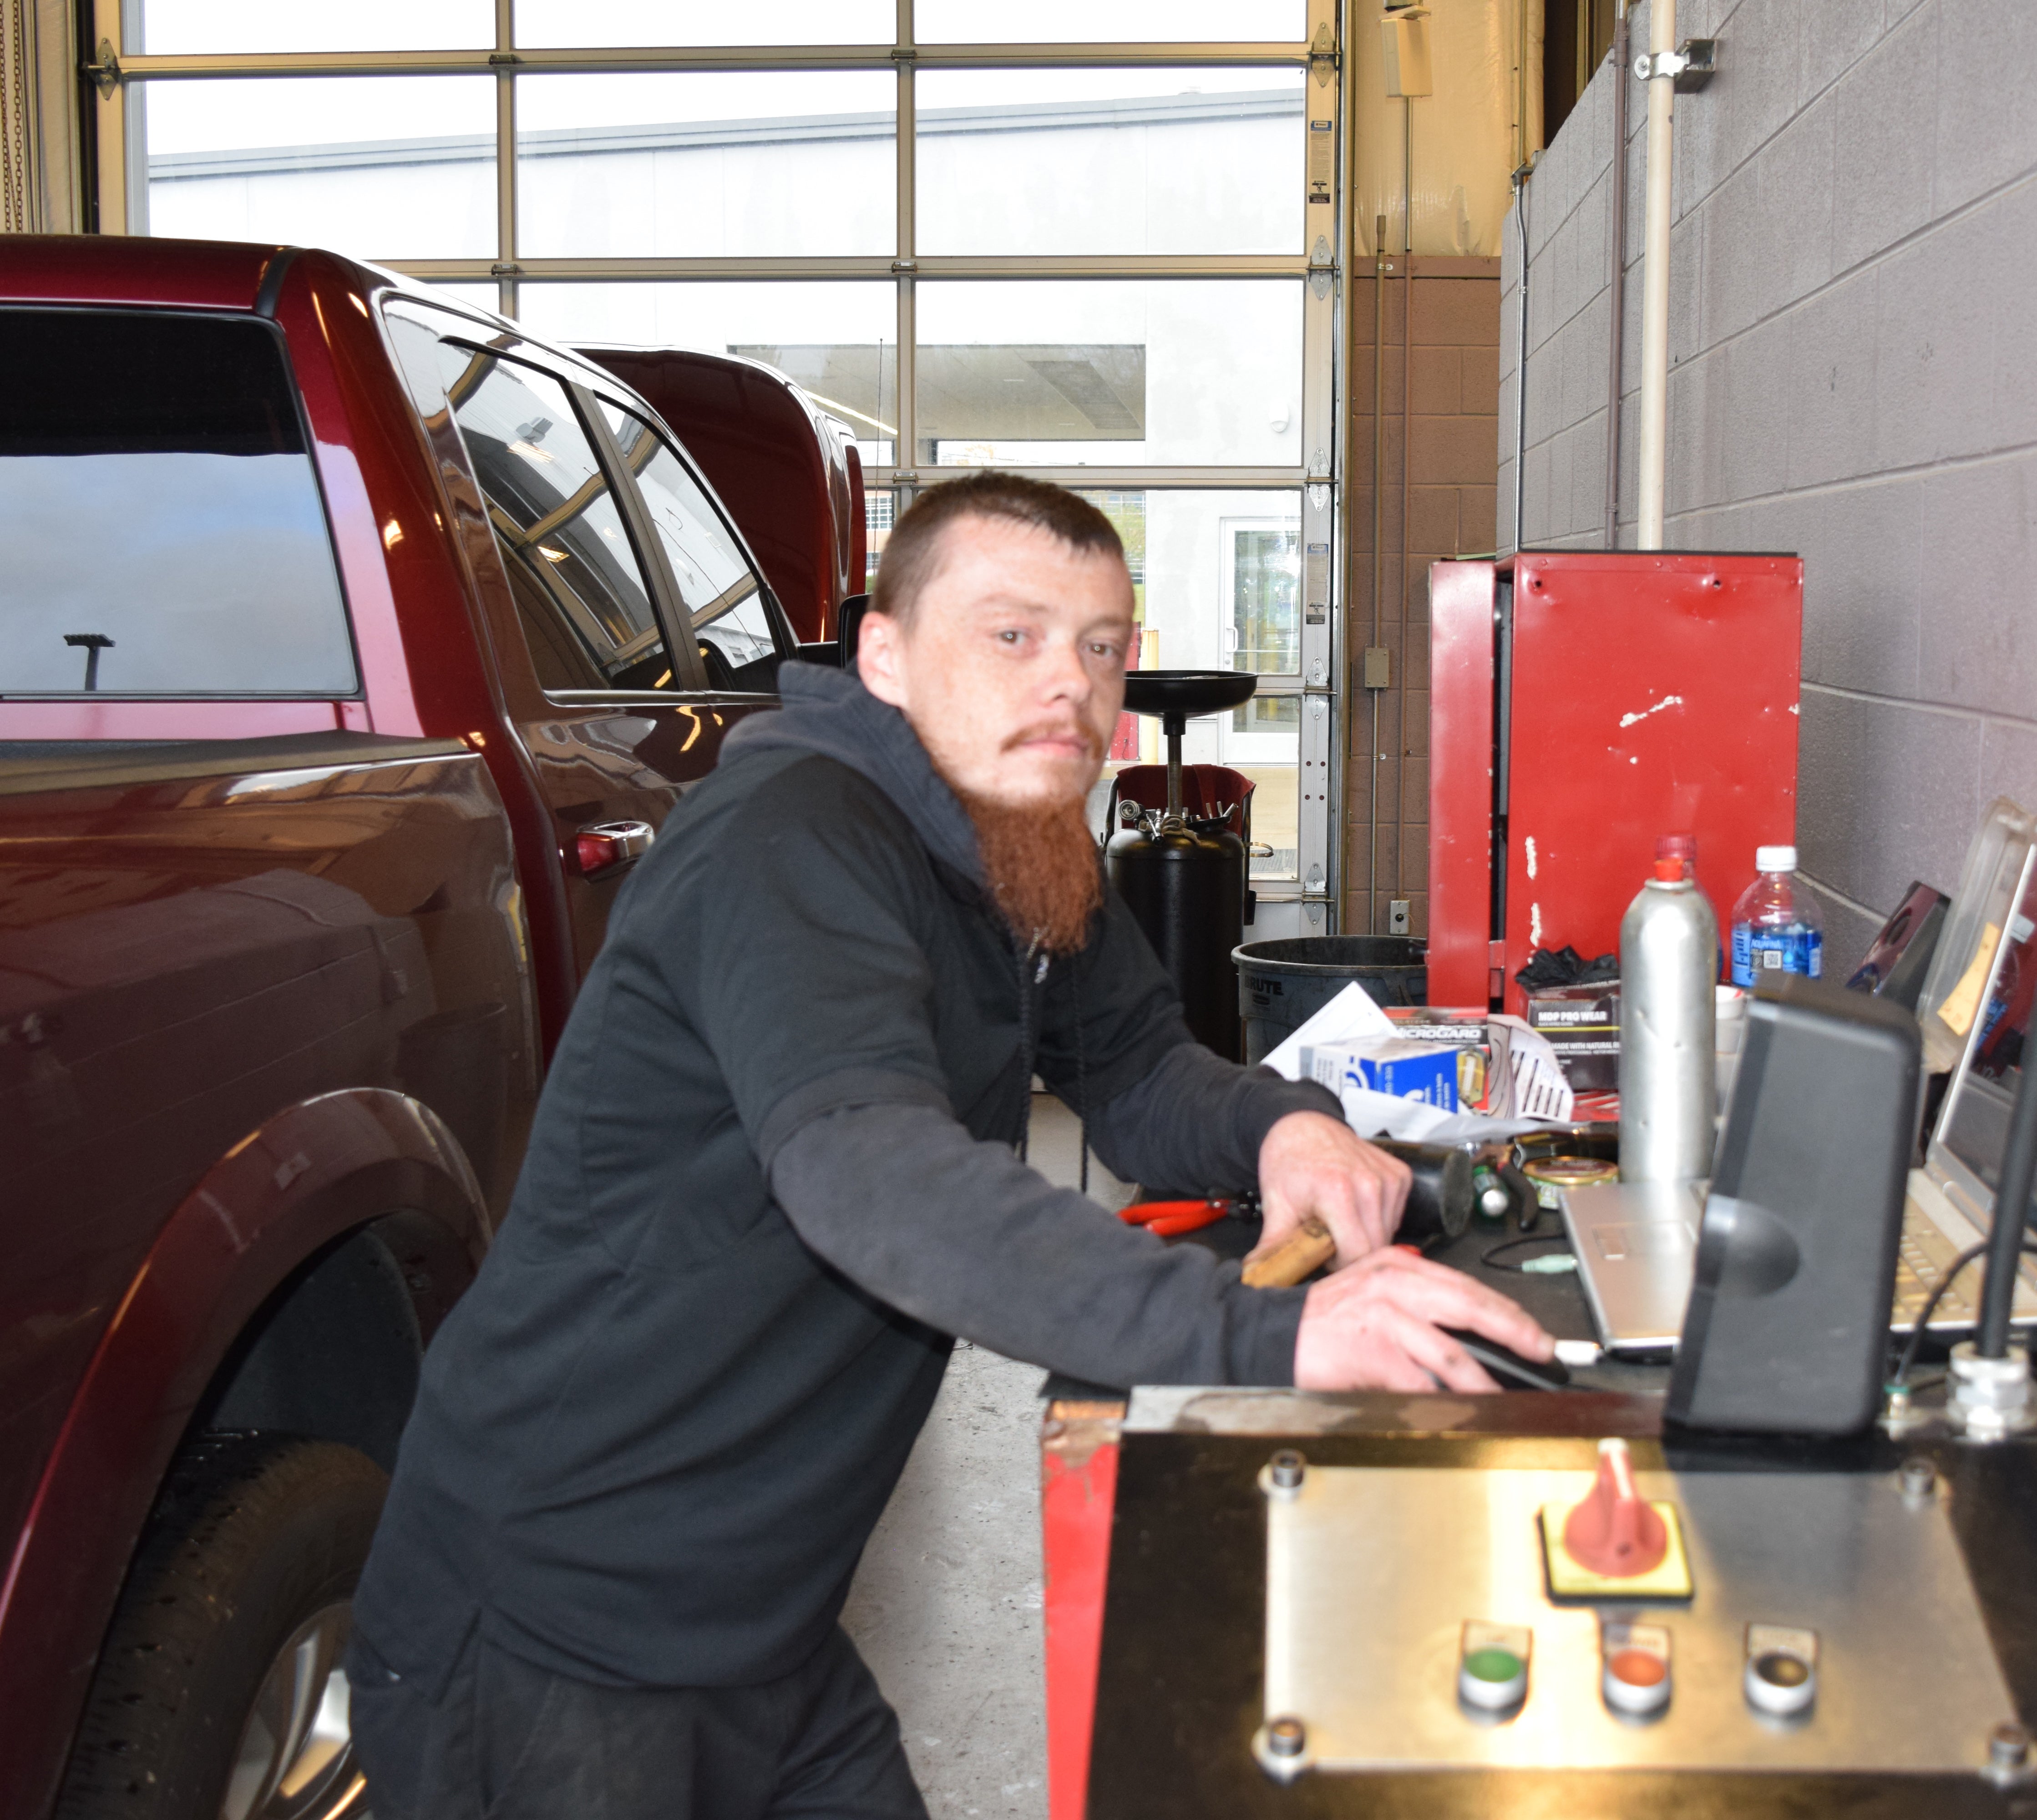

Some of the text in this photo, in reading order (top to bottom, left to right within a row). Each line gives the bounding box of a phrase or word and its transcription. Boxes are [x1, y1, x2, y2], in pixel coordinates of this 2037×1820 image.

[1245, 975, 1284, 996] BRUTE
[1561, 1011, 1580, 1021] PRO
[1580, 1011, 1607, 1021] WEAR
